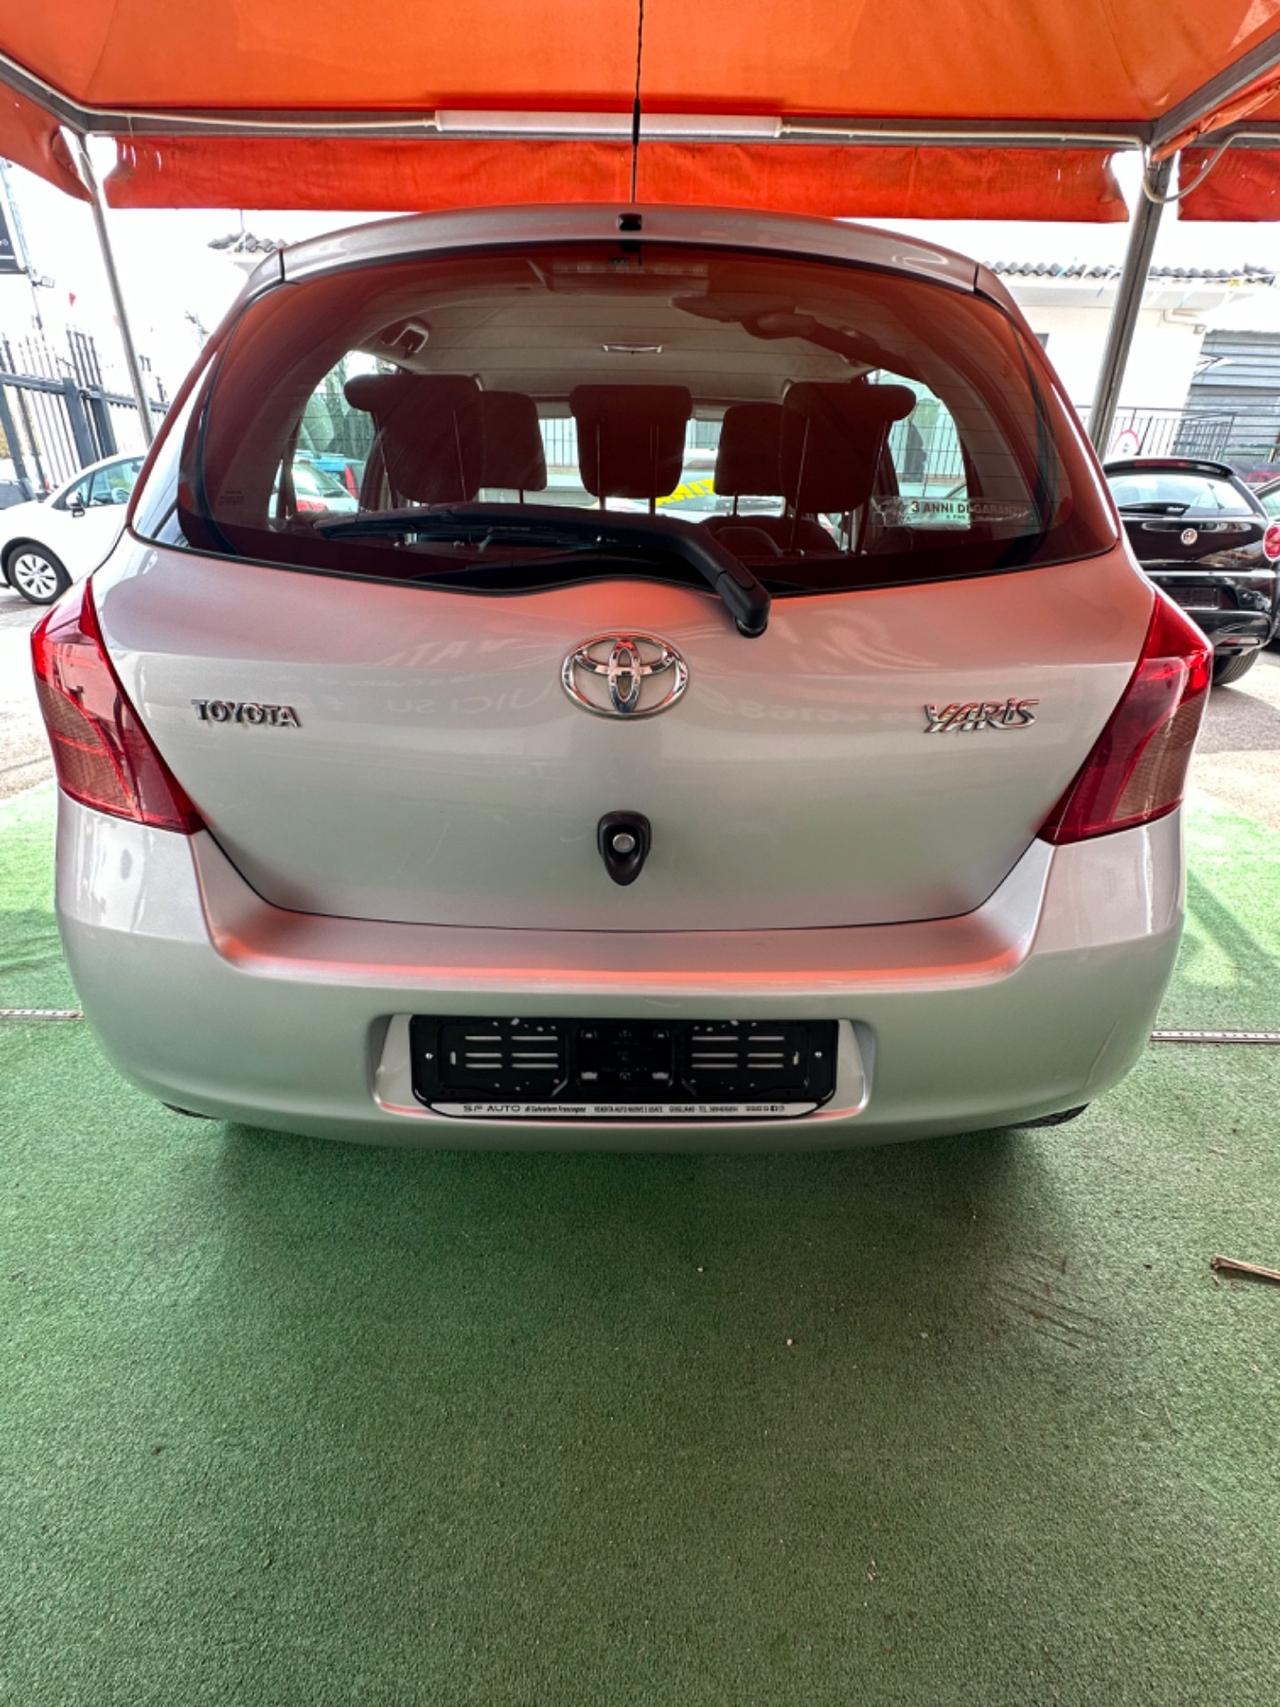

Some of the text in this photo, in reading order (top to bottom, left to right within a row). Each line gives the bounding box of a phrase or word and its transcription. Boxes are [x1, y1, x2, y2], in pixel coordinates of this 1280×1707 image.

[911, 501, 920, 513] 3
[924, 502, 954, 514] ANNI
[191, 699, 302, 728] TOYOTA
[923, 697, 1040, 734] YARIS
[487, 1104, 521, 1113] AUTO
